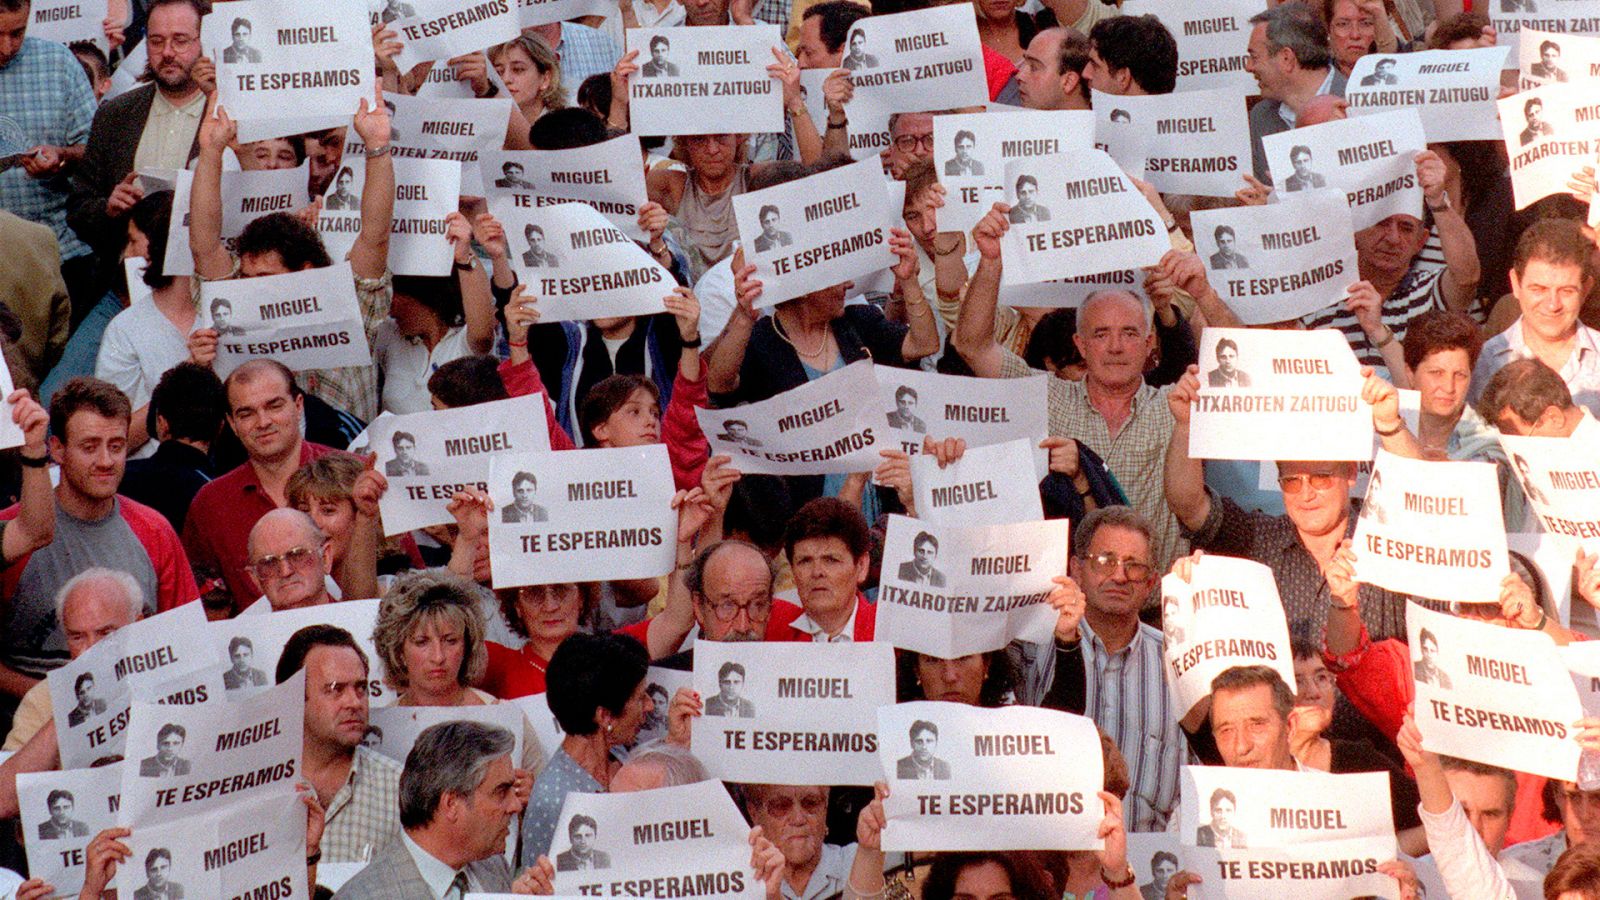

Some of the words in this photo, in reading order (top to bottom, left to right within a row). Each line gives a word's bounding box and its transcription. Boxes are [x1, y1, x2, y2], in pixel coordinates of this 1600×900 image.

[35, 5, 82, 23] MIGUEL
[402, 25, 421, 41] TE
[420, 0, 509, 38] ESPERAMOS
[1570, 18, 1600, 32] ZAIT
[277, 26, 338, 45] MIGUEL
[1184, 17, 1239, 35] MIGUEL
[895, 32, 949, 53] MIGUEL
[698, 50, 750, 65] MIGUEL
[914, 58, 973, 80] ZAITUGU
[1418, 62, 1470, 74] MIGUEL
[237, 74, 255, 91] TE
[261, 69, 360, 90] ESPERAMOS
[633, 81, 709, 98] ITXAROTEN
[713, 80, 771, 96] ZAITUGU
[1349, 89, 1425, 107] ITXAROTEN
[1429, 86, 1489, 103] ZAITUGU
[421, 121, 476, 136] MIGUEL
[1157, 117, 1216, 134] MIGUEL
[1338, 140, 1398, 166] MIGUEL
[1513, 141, 1589, 171] ITXAROTEN
[551, 169, 612, 185] MIGUEL
[1066, 176, 1128, 200] MIGUEL
[397, 185, 428, 200] GUEL
[512, 194, 531, 208] TE
[960, 187, 979, 203] TE
[1347, 173, 1414, 208] PERAMOS
[241, 194, 293, 213] MIGUEL
[804, 192, 860, 222] MIGUEL
[391, 218, 447, 234] ZAITUGU
[1027, 234, 1047, 252] TE
[1052, 219, 1156, 249] ESPERAMOS
[1262, 225, 1321, 250] MIGUEL
[570, 228, 630, 249] MIGUEL
[772, 257, 791, 276] TE
[795, 228, 883, 270] ESPERAMOS
[541, 278, 556, 296] TE
[561, 266, 662, 295] ESPERAMOS
[1228, 279, 1246, 297] TE
[1250, 259, 1344, 296] ESPERAMOS
[259, 296, 323, 320] MIGUEL
[224, 343, 244, 355] TE
[247, 331, 350, 355] ESPERAMOS
[1272, 358, 1333, 375] MIGUEL
[945, 404, 1010, 423] MIGUEL
[1195, 396, 1284, 413] ITXAROTEN
[1290, 395, 1358, 413] ZAITUGU
[778, 399, 844, 433] MIGUEL
[445, 432, 513, 457] MIGUEL
[765, 428, 875, 462] ESPERAMOS
[568, 479, 637, 501] MIGUEL
[1549, 470, 1600, 489] MIGUEL
[406, 485, 428, 500] TE
[932, 480, 997, 508] MIGUEL
[1404, 491, 1468, 516] MIGUEL
[1543, 514, 1560, 533] TE
[520, 535, 541, 553] TE
[548, 527, 662, 552] ESPERAMOS
[1366, 534, 1381, 555] TE
[1387, 542, 1491, 569] ESPERAMOS
[971, 554, 1031, 576] MIGUEL
[882, 585, 978, 613] ITXAROTEN
[1192, 588, 1249, 613] MIGUEL
[115, 645, 178, 682] MIGUEL
[1172, 658, 1182, 679] TE
[1183, 639, 1277, 672] ESPERAMOS
[1466, 654, 1532, 686] MIGUEL
[778, 677, 853, 699] MIGUEL
[1430, 699, 1450, 722] TE
[1455, 704, 1567, 740] ESPERAMOS
[87, 726, 106, 748] TE
[215, 718, 281, 752] MIGUEL
[724, 730, 746, 750] TE
[753, 731, 877, 753] ESPERAMOS
[974, 735, 1055, 757] MIGUEL
[155, 789, 175, 808] TE
[182, 759, 295, 803] ESPERAMOS
[918, 794, 942, 816] TE
[950, 793, 1083, 816] ESPERAMOS
[1270, 807, 1347, 830] MIGUEL
[633, 818, 714, 845] MIGUEL
[60, 849, 84, 868] TE
[204, 832, 269, 871] MIGUEL
[1217, 861, 1242, 880] TE
[1249, 858, 1377, 880] ESPERAMOS
[611, 871, 745, 899] ESPERAMOS
